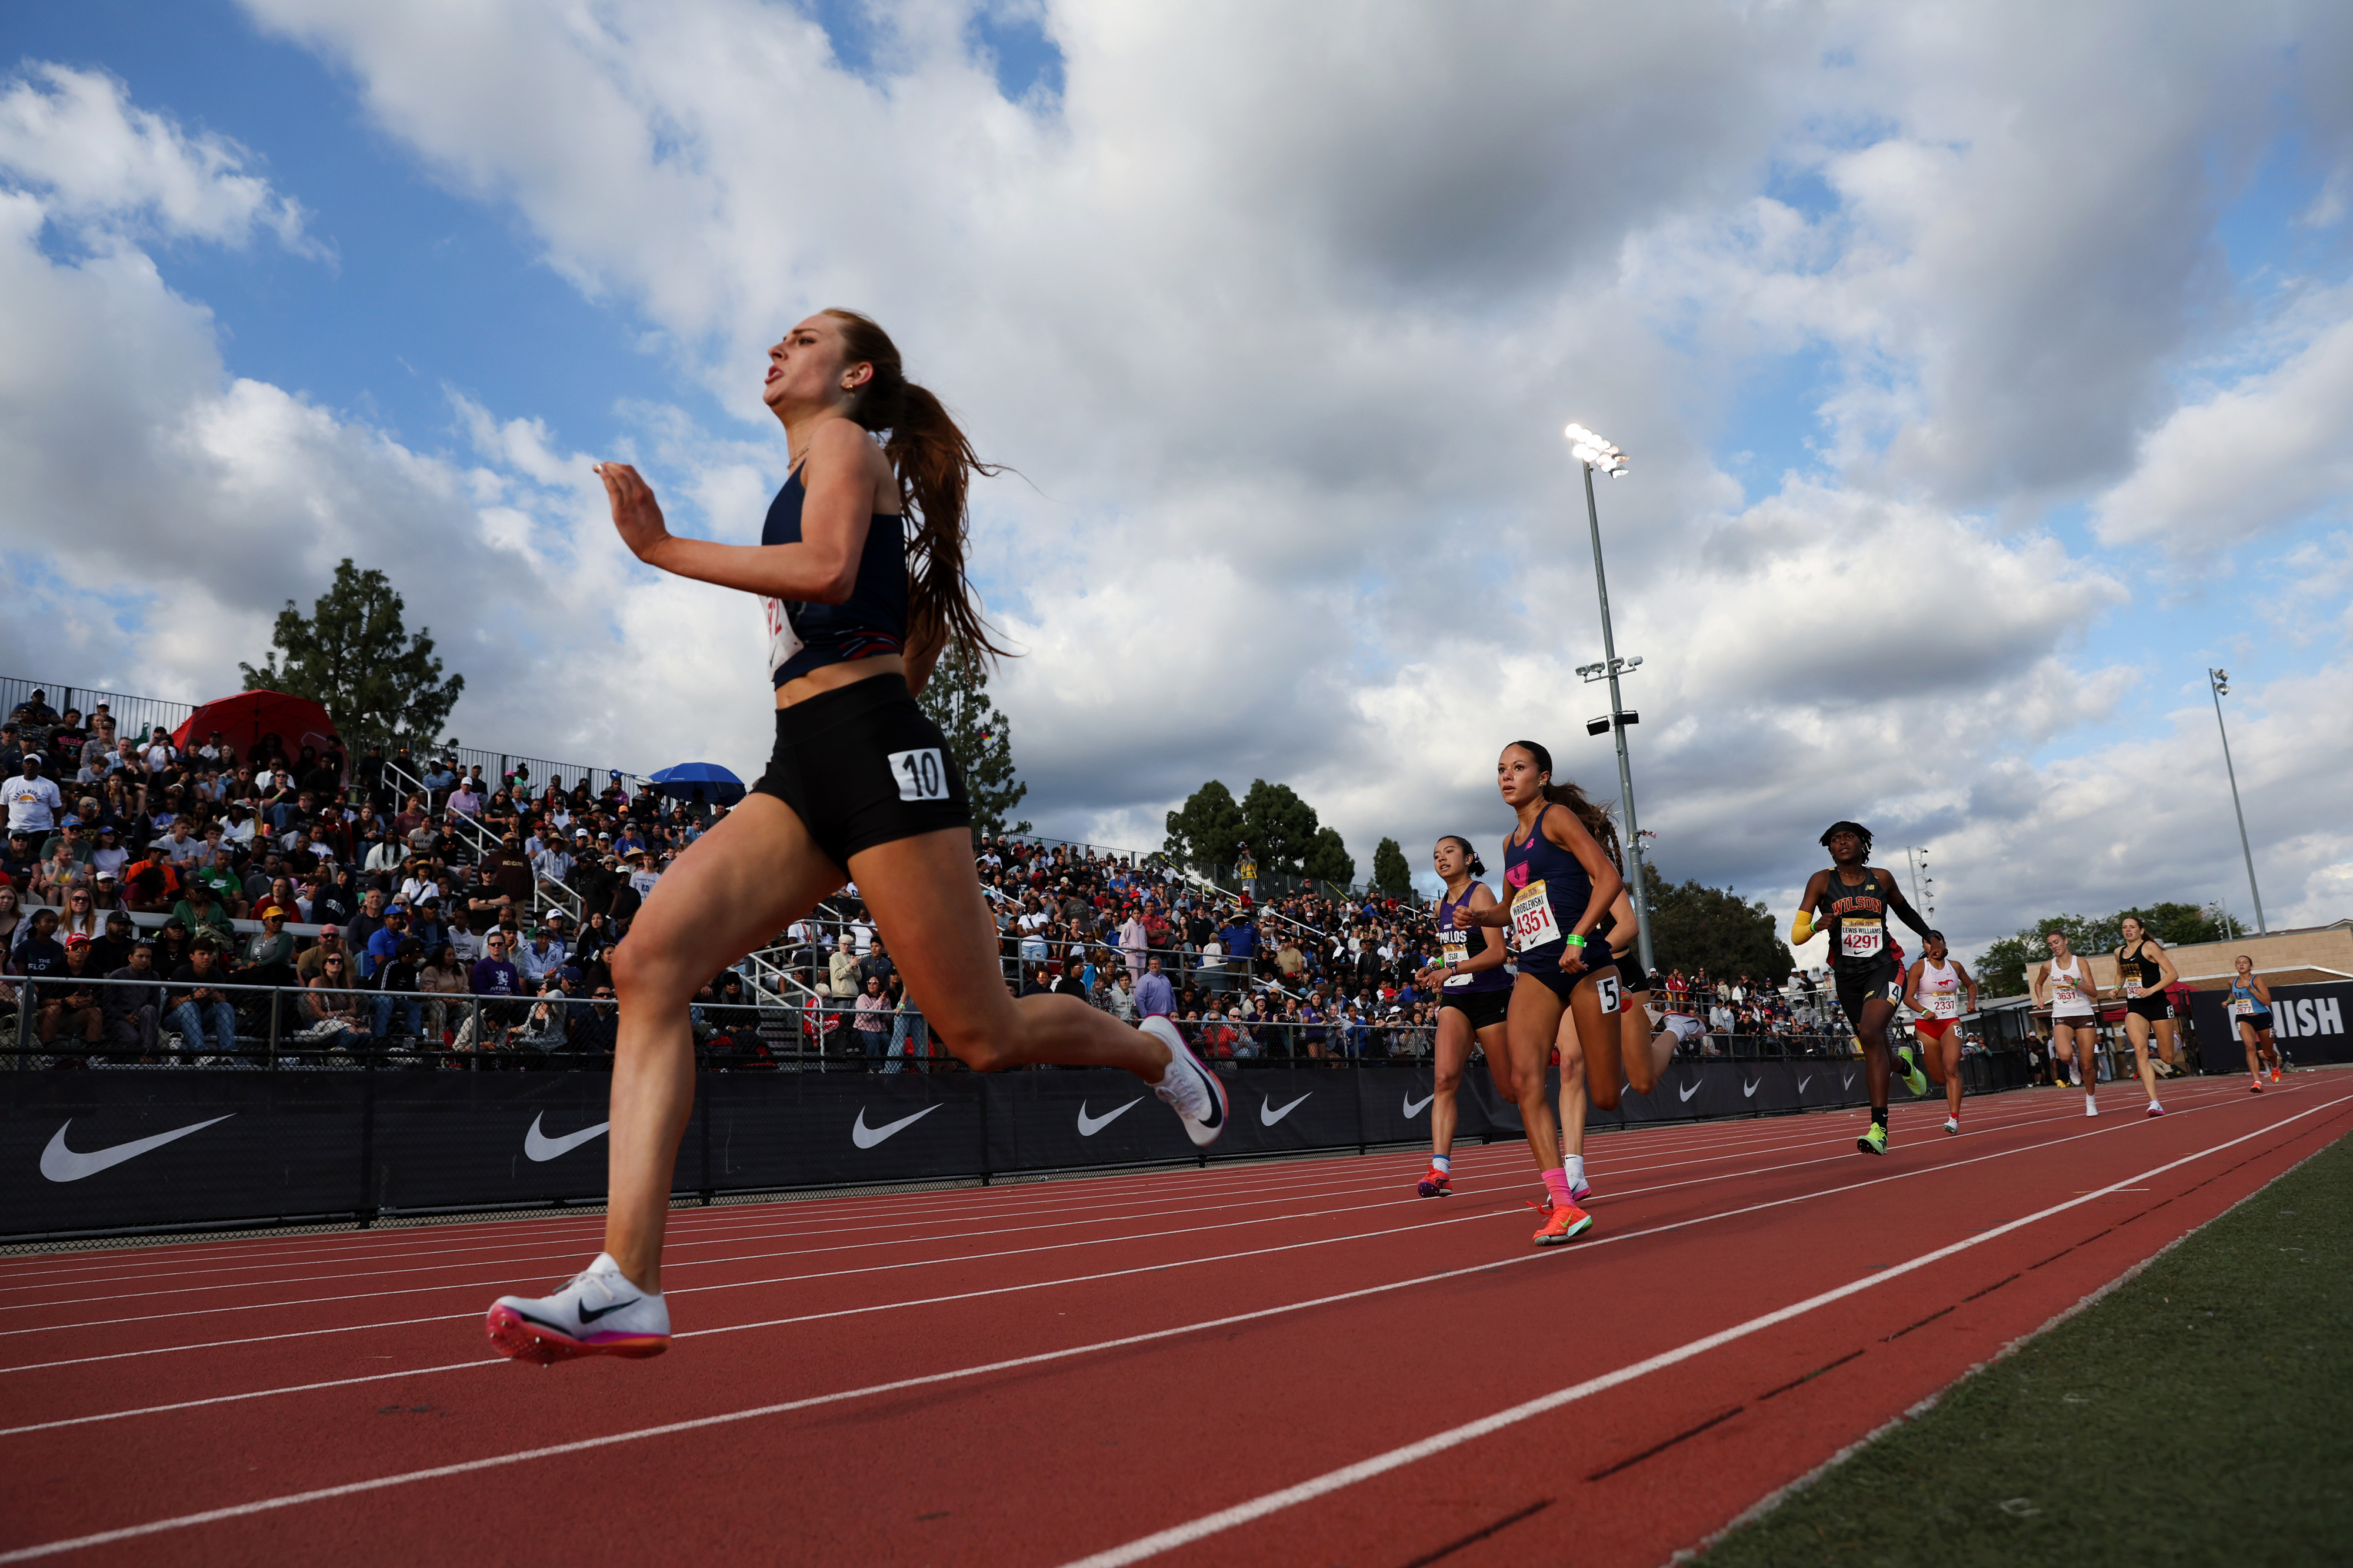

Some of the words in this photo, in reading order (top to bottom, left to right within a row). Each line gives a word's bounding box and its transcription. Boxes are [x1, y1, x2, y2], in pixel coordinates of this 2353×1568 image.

[903, 752, 939, 798] 10
[1512, 895, 1544, 916] WROBLEWSKI
[1831, 896, 1882, 915] WILSON
[1517, 906, 1550, 936] 4351
[1439, 930, 1467, 945] POLLOS
[1844, 934, 1878, 948] 4291
[1603, 979, 1617, 1011] 5
[1892, 986, 1899, 1002] 4
[2057, 992, 2076, 1000] 3631
[1934, 1000, 1955, 1010] 2337
[2169, 1006, 2174, 1017] 6
[1956, 1026, 1962, 1037] 8
